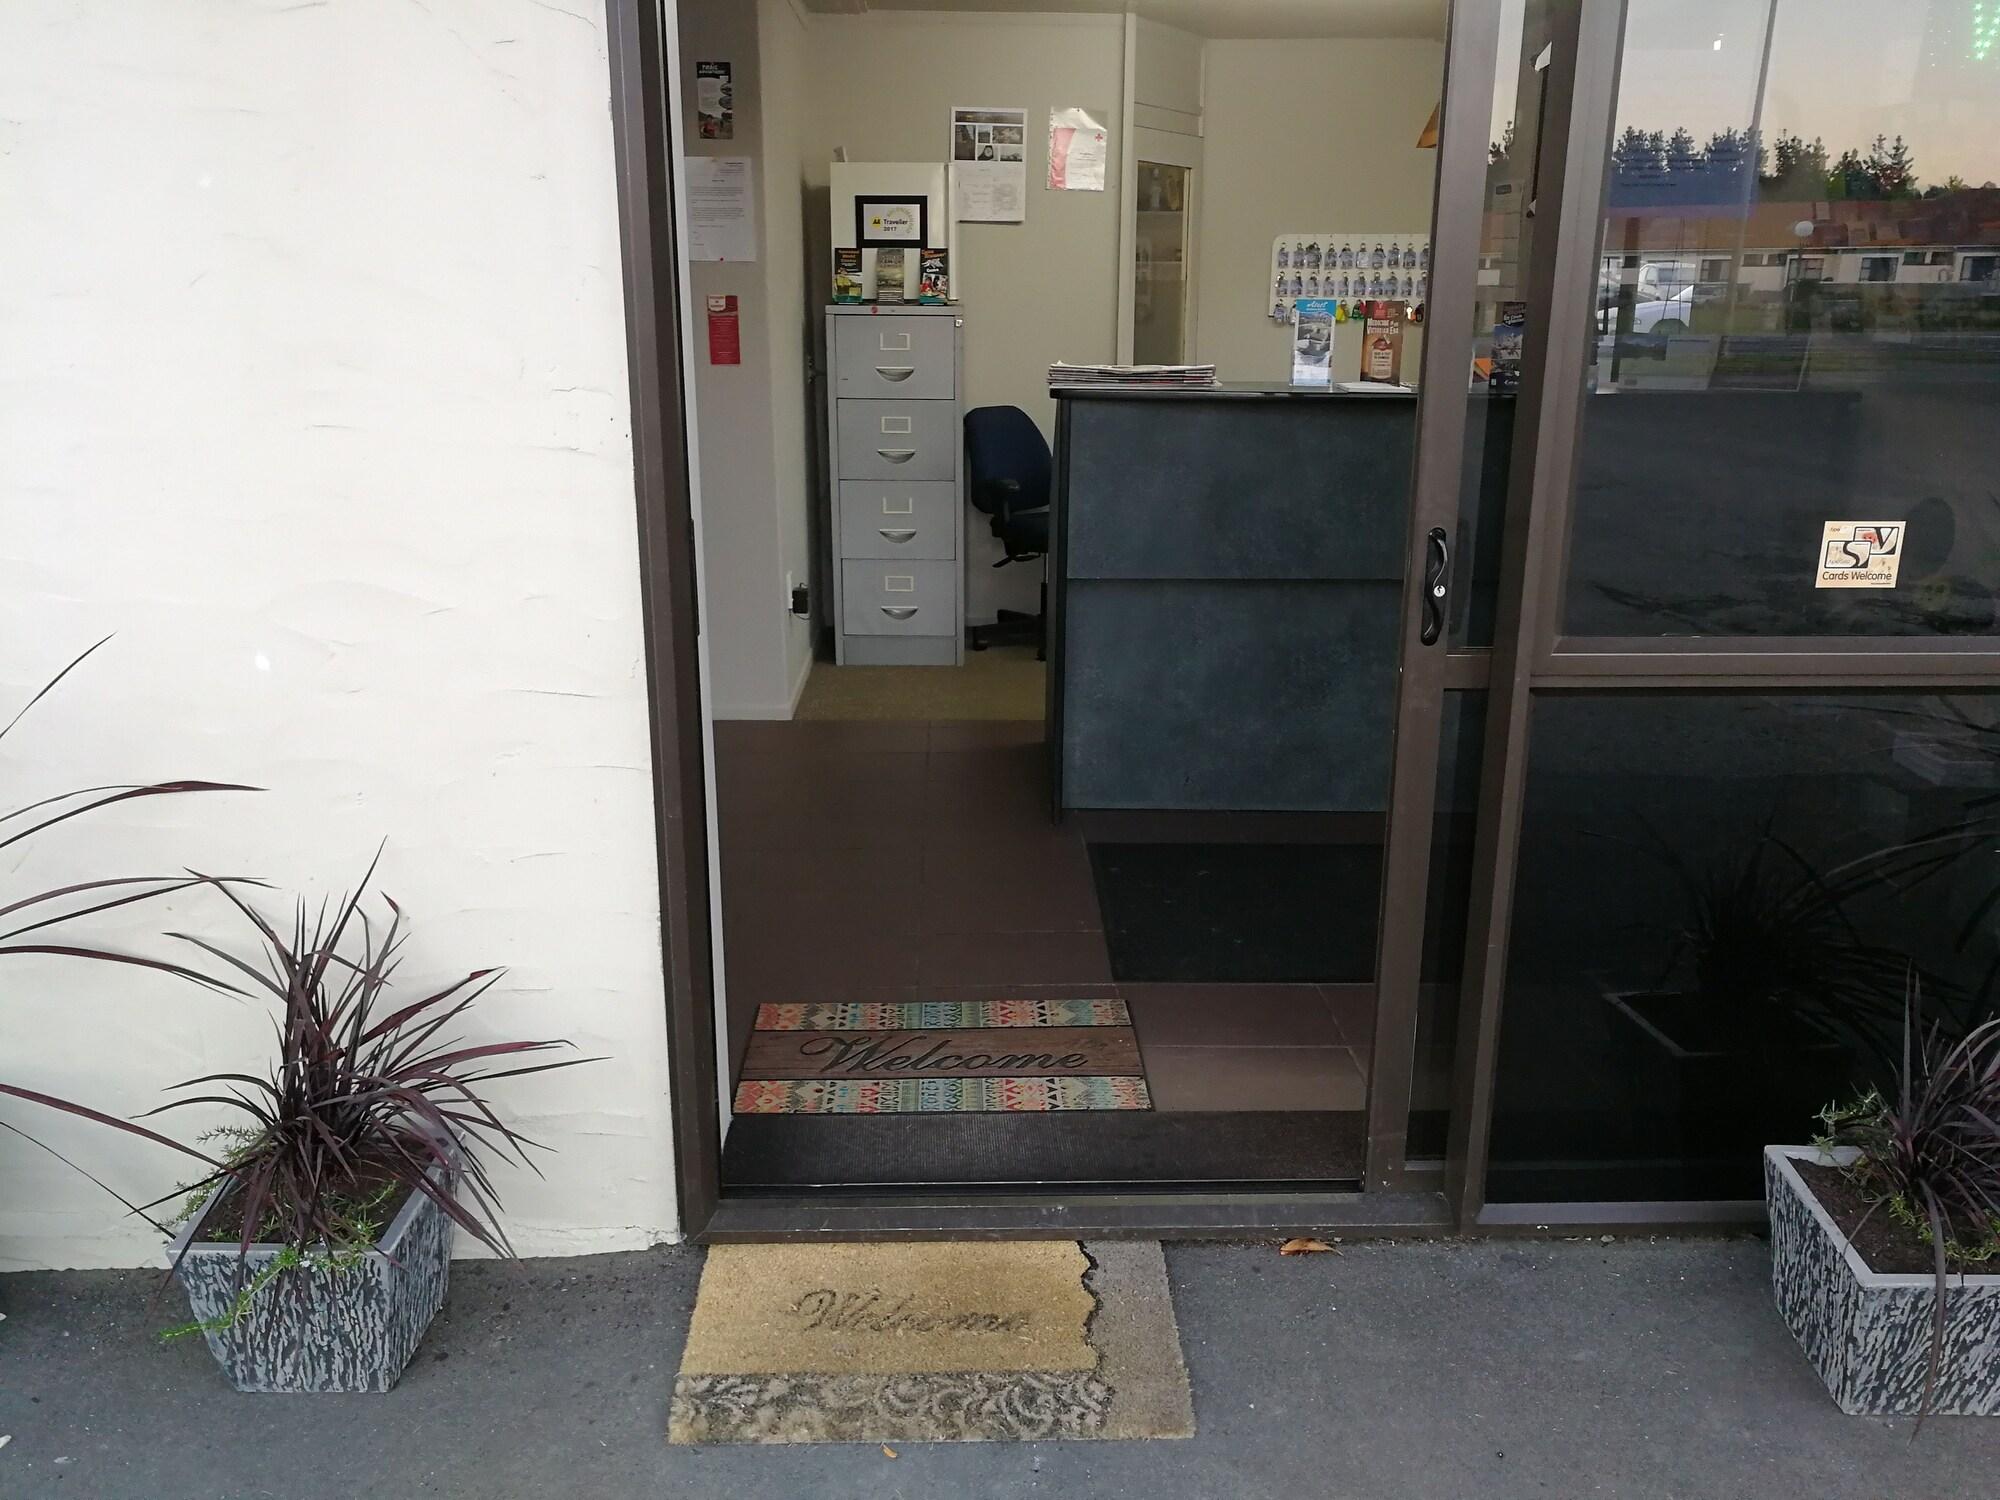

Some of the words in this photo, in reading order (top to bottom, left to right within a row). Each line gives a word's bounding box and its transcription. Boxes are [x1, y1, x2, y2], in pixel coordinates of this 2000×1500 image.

[1822, 571, 1849, 581] Cards
[1851, 571, 1892, 581] Welcome
[800, 1035, 1088, 1074] Welcome
